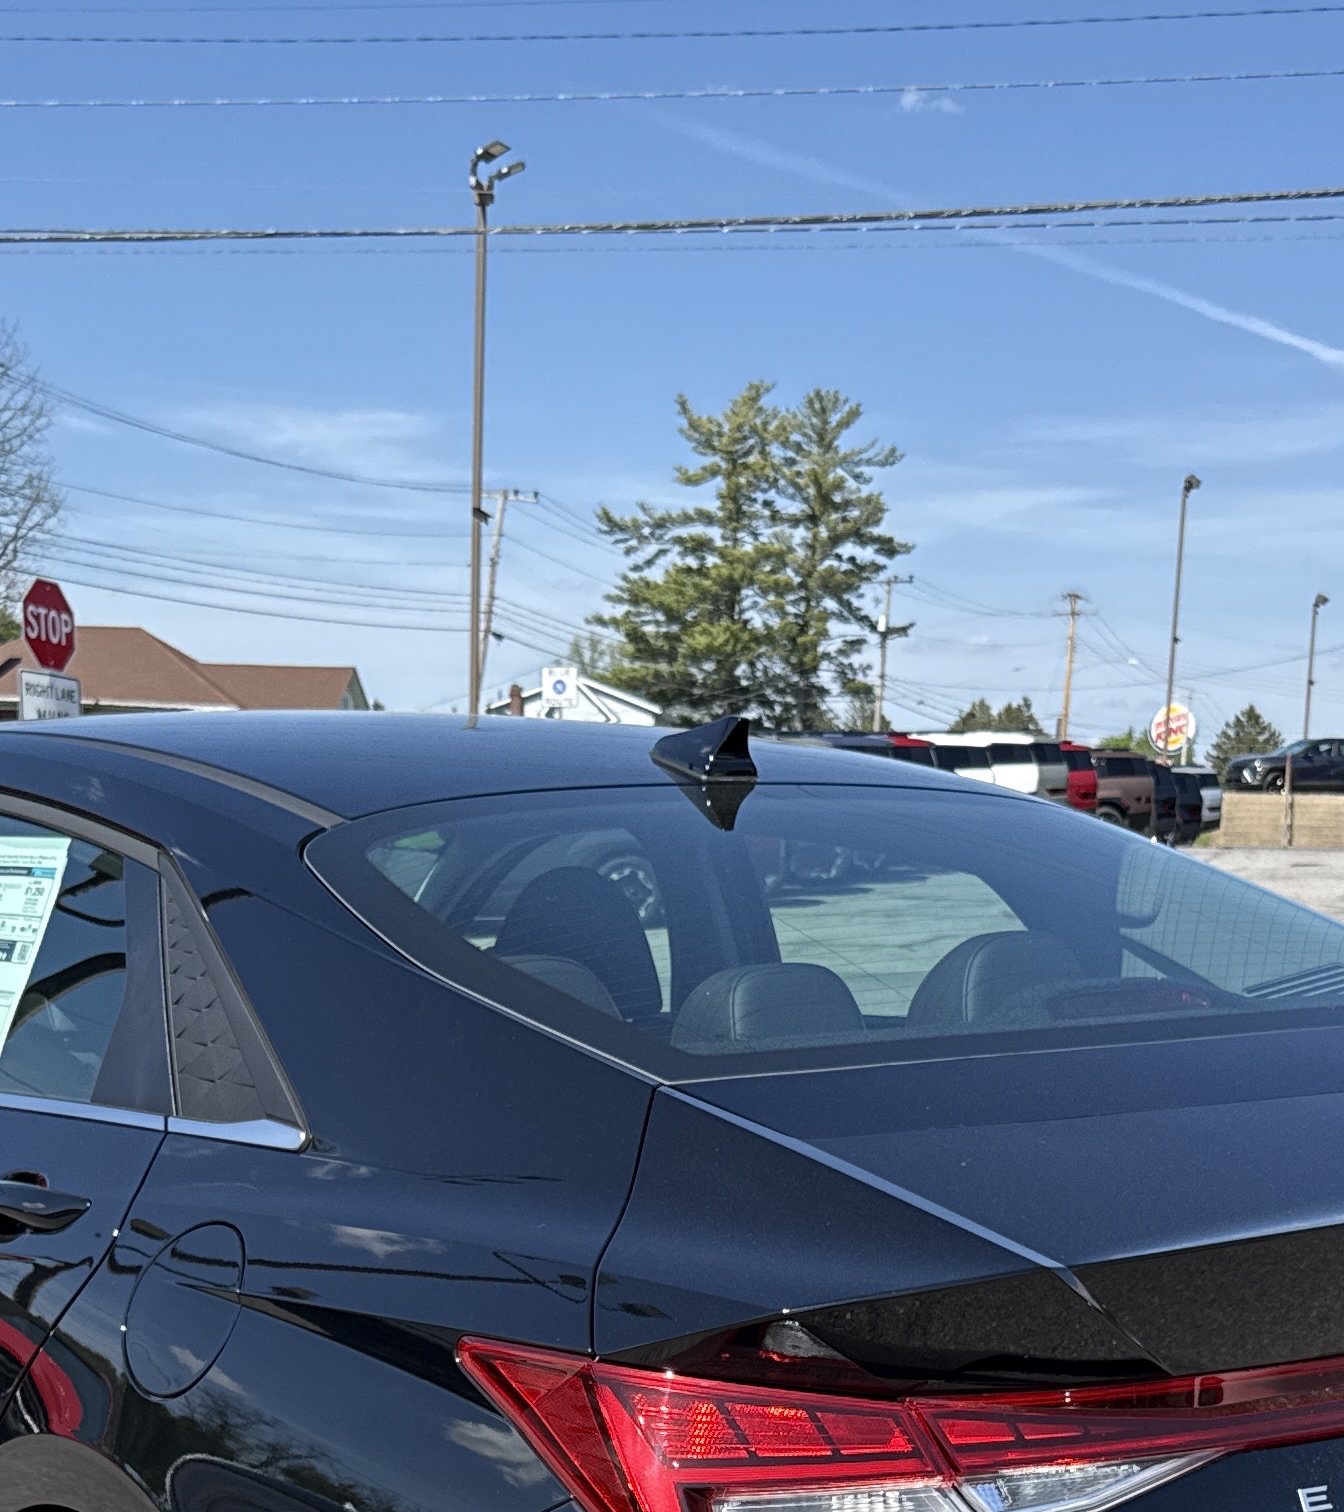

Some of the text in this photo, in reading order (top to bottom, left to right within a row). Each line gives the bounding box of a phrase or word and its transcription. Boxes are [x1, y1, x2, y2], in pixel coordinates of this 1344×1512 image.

[26, 604, 73, 647] STOP
[25, 682, 76, 704] RIGHT LANE
[1155, 725, 1185, 744] KNG
